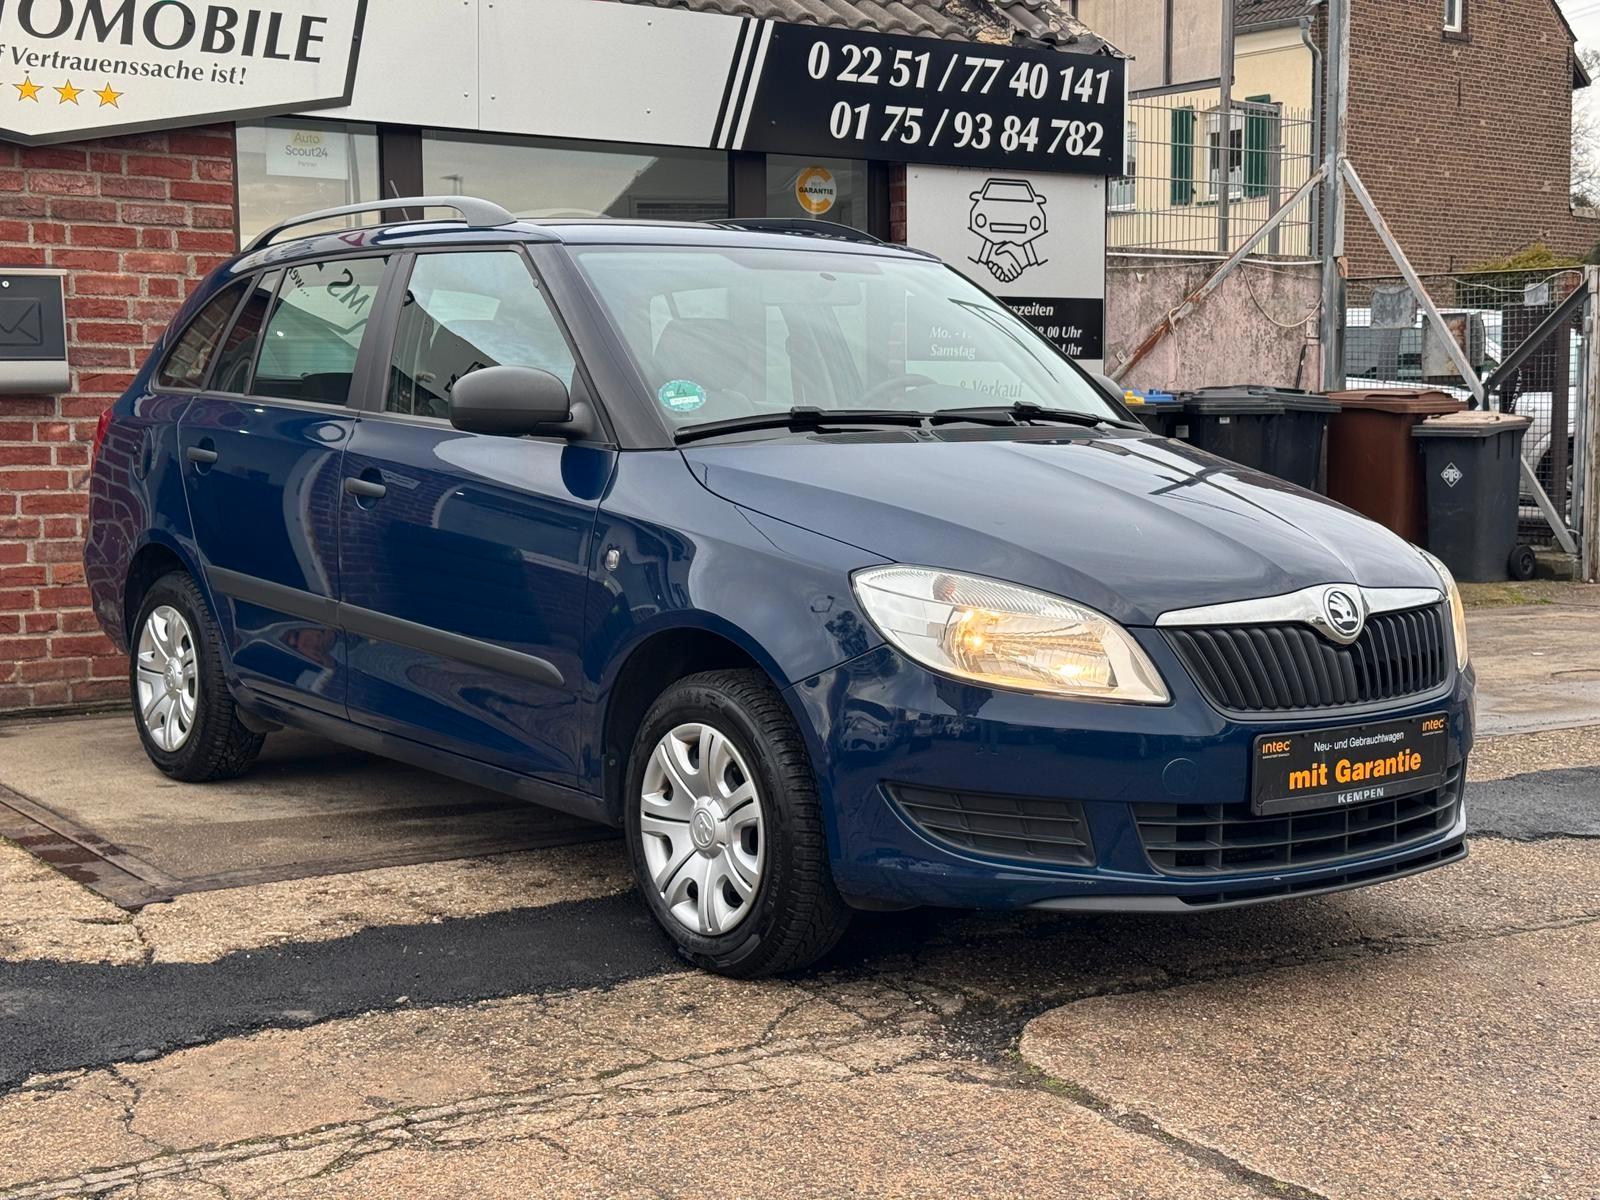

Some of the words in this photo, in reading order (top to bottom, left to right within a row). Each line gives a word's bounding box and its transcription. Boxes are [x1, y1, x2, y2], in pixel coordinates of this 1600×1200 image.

[0, 0, 328, 63] OMOBILE
[12, 46, 204, 82] Vertrauenssache
[210, 63, 248, 87] ist!
[807, 40, 830, 80] 0
[836, 45, 882, 84] 22
[889, 50, 931, 89] 51
[961, 57, 1005, 95] 77
[1009, 62, 1049, 100] 40
[1059, 66, 1112, 105] 141
[294, 131, 321, 144] Auto
[829, 101, 871, 140] 01
[880, 105, 925, 145] 75
[953, 112, 993, 150] 93
[1000, 115, 1040, 152] 84
[1046, 119, 1104, 157] 782
[285, 145, 328, 159] Scout24
[798, 186, 834, 195] GARANTIE
[930, 326, 951, 338] Mo.
[1062, 325, 1083, 338] Uhr
[931, 344, 976, 360] Samstag
[1062, 343, 1083, 355] Uhr
[1422, 718, 1445, 732] intec
[1262, 740, 1291, 754] intec
[1313, 742, 1332, 752] Neu-
[1334, 739, 1348, 750] und
[1349, 732, 1404, 748] Gebrauchtwagen
[1289, 762, 1328, 790] mit
[1335, 748, 1422, 784] Garantie
[1337, 787, 1384, 804] KEMPEN
